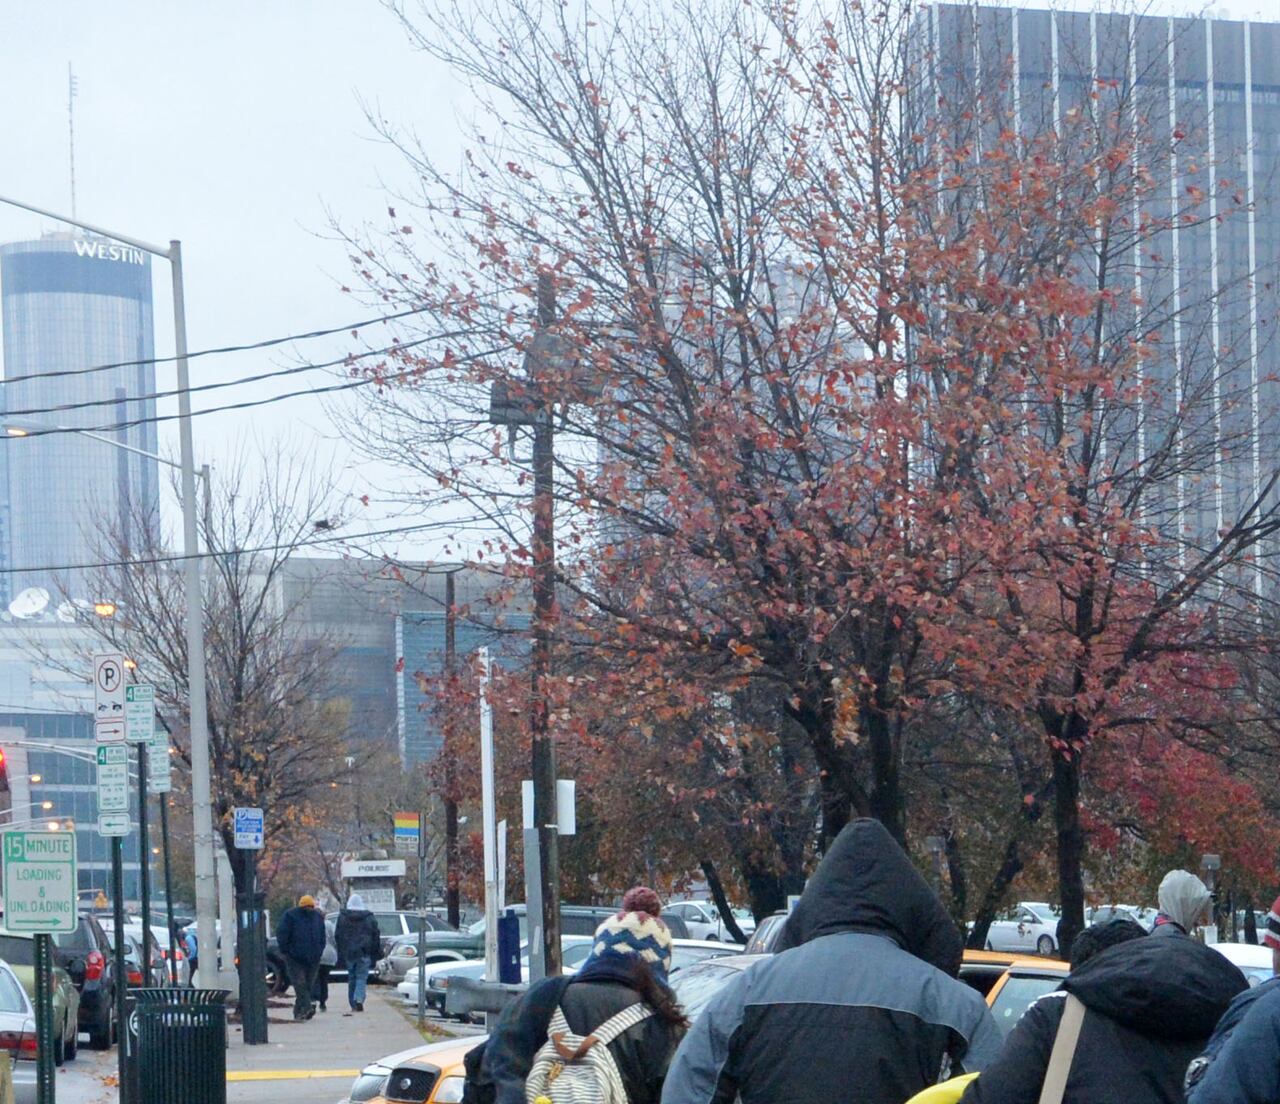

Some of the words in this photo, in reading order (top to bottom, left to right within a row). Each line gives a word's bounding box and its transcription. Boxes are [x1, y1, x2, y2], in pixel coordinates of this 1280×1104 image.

[73, 240, 144, 265] WESTIN
[7, 837, 23, 858] 15
[26, 840, 70, 854] MINUTE
[16, 868, 62, 881] LOADING
[38, 886, 46, 898] &
[10, 901, 70, 913] UNLOADING
